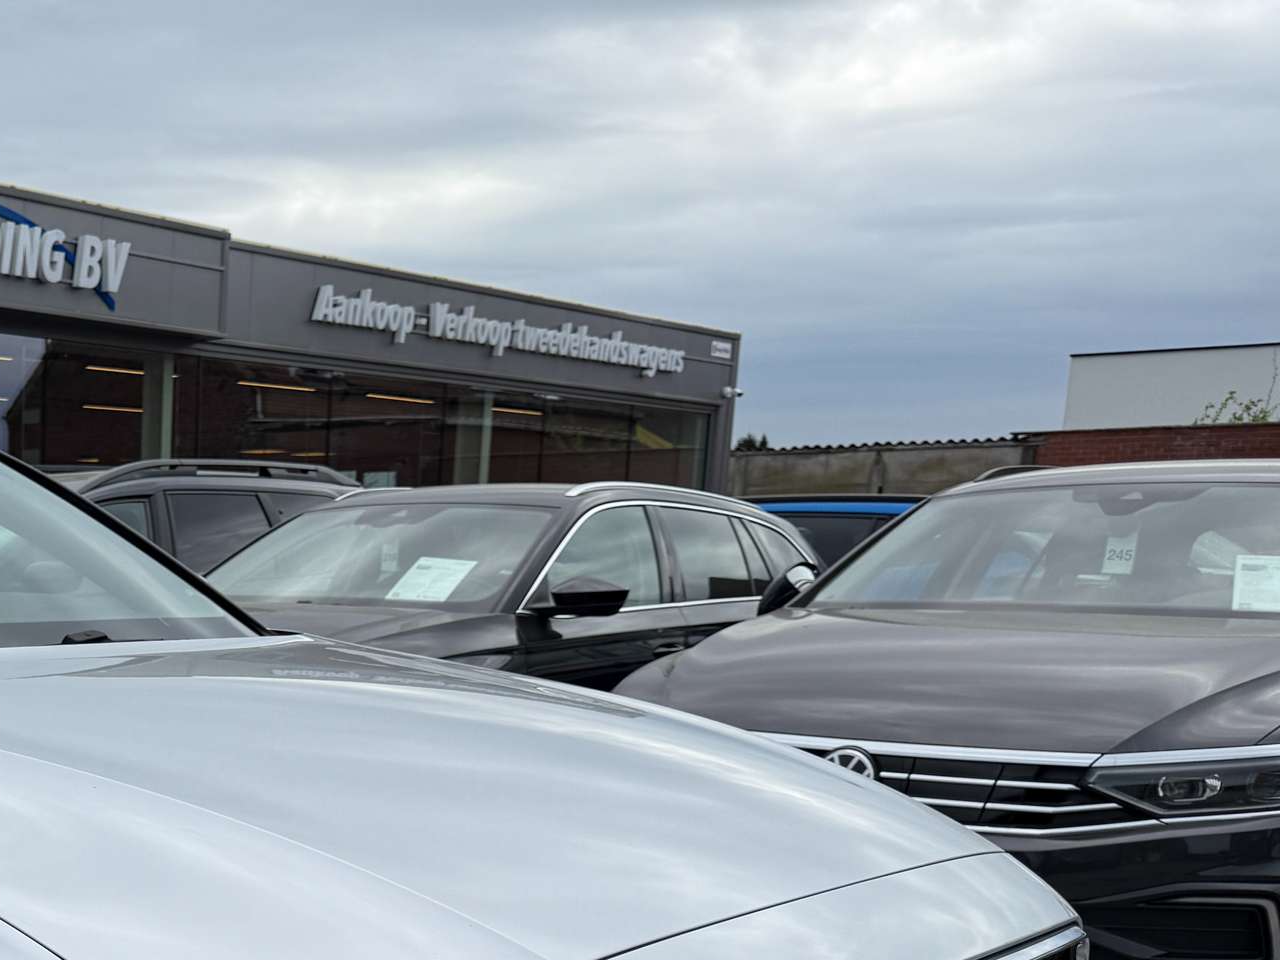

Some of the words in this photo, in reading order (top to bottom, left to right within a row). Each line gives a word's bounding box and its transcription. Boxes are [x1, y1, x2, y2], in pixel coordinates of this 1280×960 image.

[73, 234, 131, 292] BV
[312, 284, 415, 343] Aankoop
[429, 302, 511, 356] Verkoop
[515, 319, 685, 377] tweedehandswagens
[1106, 549, 1133, 562] 245
